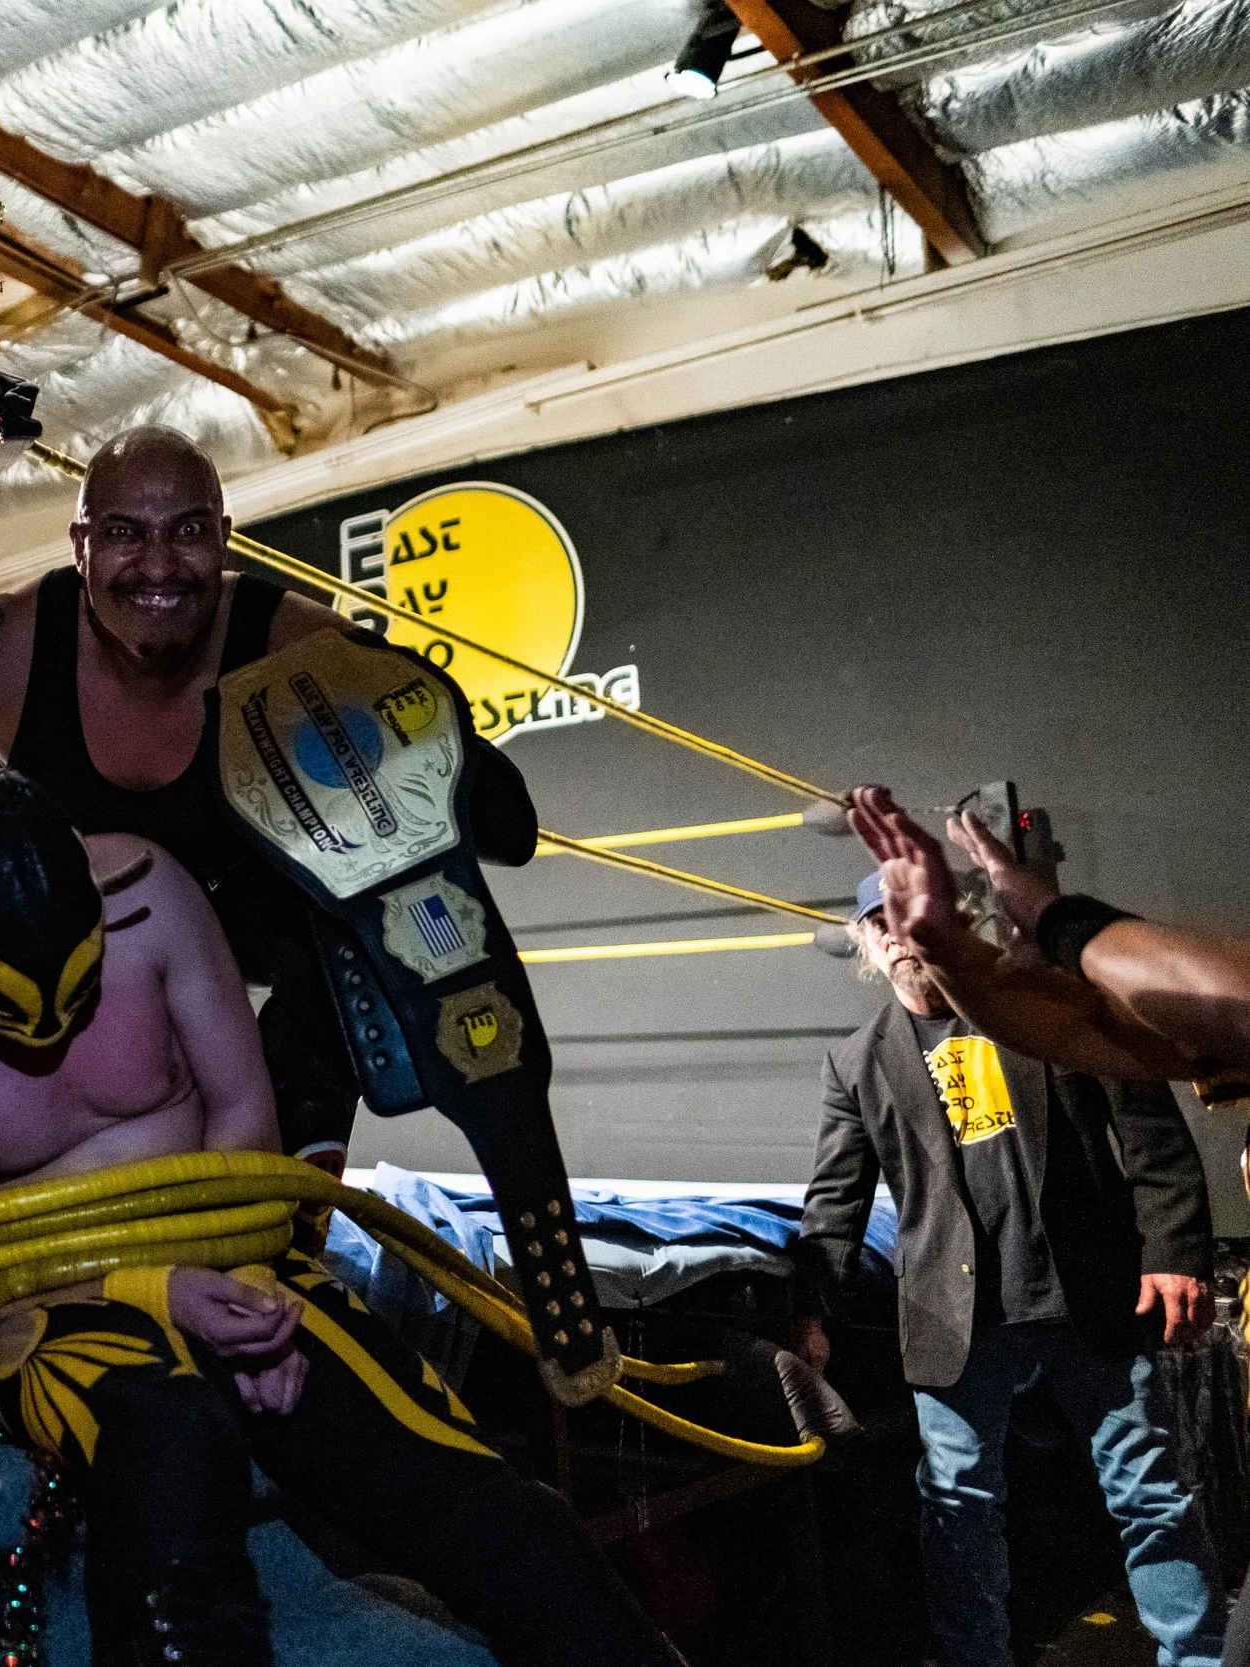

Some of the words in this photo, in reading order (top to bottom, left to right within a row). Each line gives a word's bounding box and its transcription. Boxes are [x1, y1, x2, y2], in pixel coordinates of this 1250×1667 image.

[340, 509, 461, 583] EAST
[243, 702, 291, 784] HEAVYWEIGHT
[283, 784, 332, 850] CHAMPION
[325, 727, 350, 756] PRO
